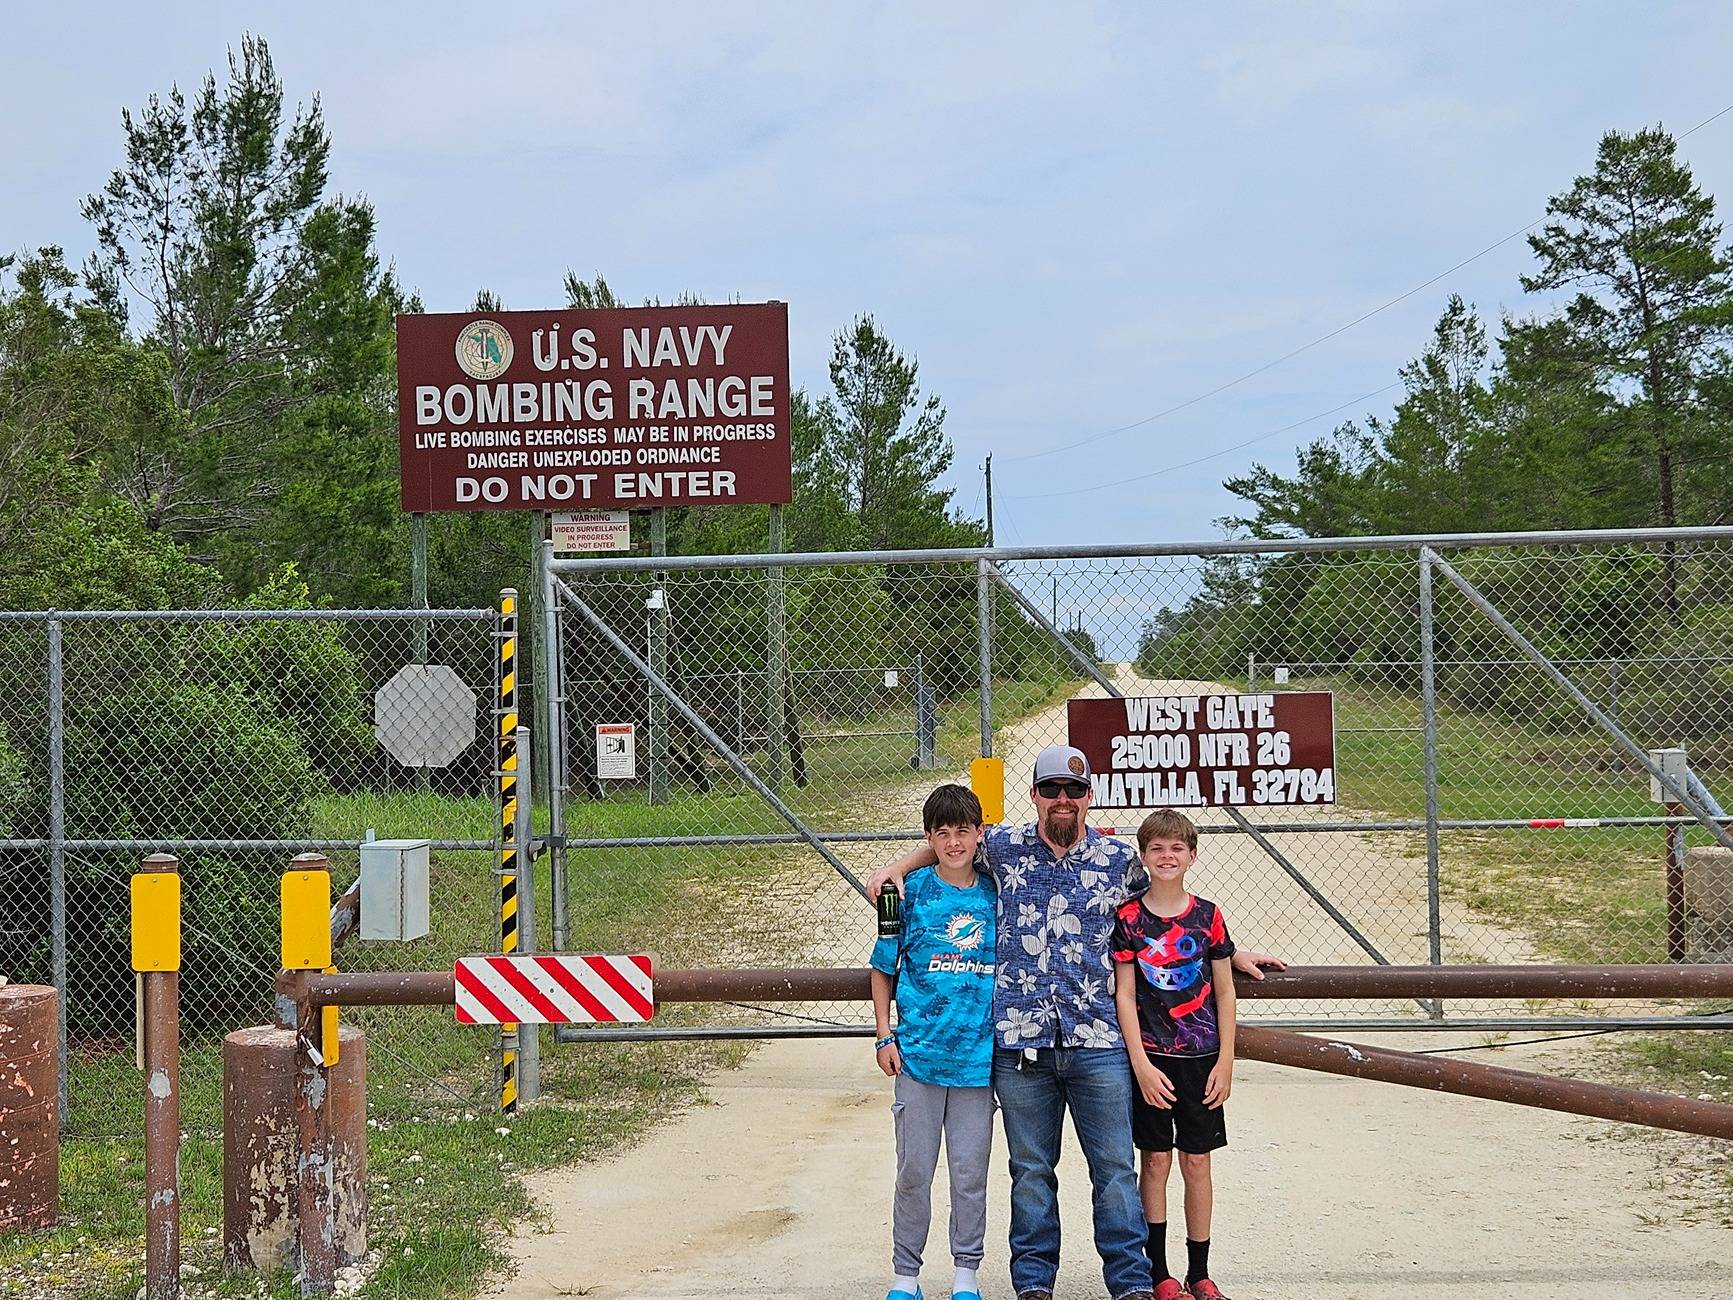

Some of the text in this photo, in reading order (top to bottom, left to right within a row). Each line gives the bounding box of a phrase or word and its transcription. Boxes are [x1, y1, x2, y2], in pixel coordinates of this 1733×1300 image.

[532, 325, 733, 371] U.S. NAVY
[416, 376, 774, 425] BOMBING RANGE
[416, 424, 775, 449] LIVE BOMBING EXERCISES MAY BE IN PROGRESS
[468, 447, 720, 469] DANGER UNEXPLODED ORDNANCE
[455, 470, 737, 503] DO NOT ENTER
[570, 513, 611, 522] WARNING
[576, 533, 614, 541] PROGRESS
[1125, 695, 1274, 732] WEST GATE
[1111, 734, 1190, 769] 25000
[1199, 733, 1250, 767] NFR
[1257, 732, 1290, 765] 26
[1213, 770, 1245, 804] FL
[1252, 768, 1334, 803] 32784
[928, 959, 995, 974] Dolphins
